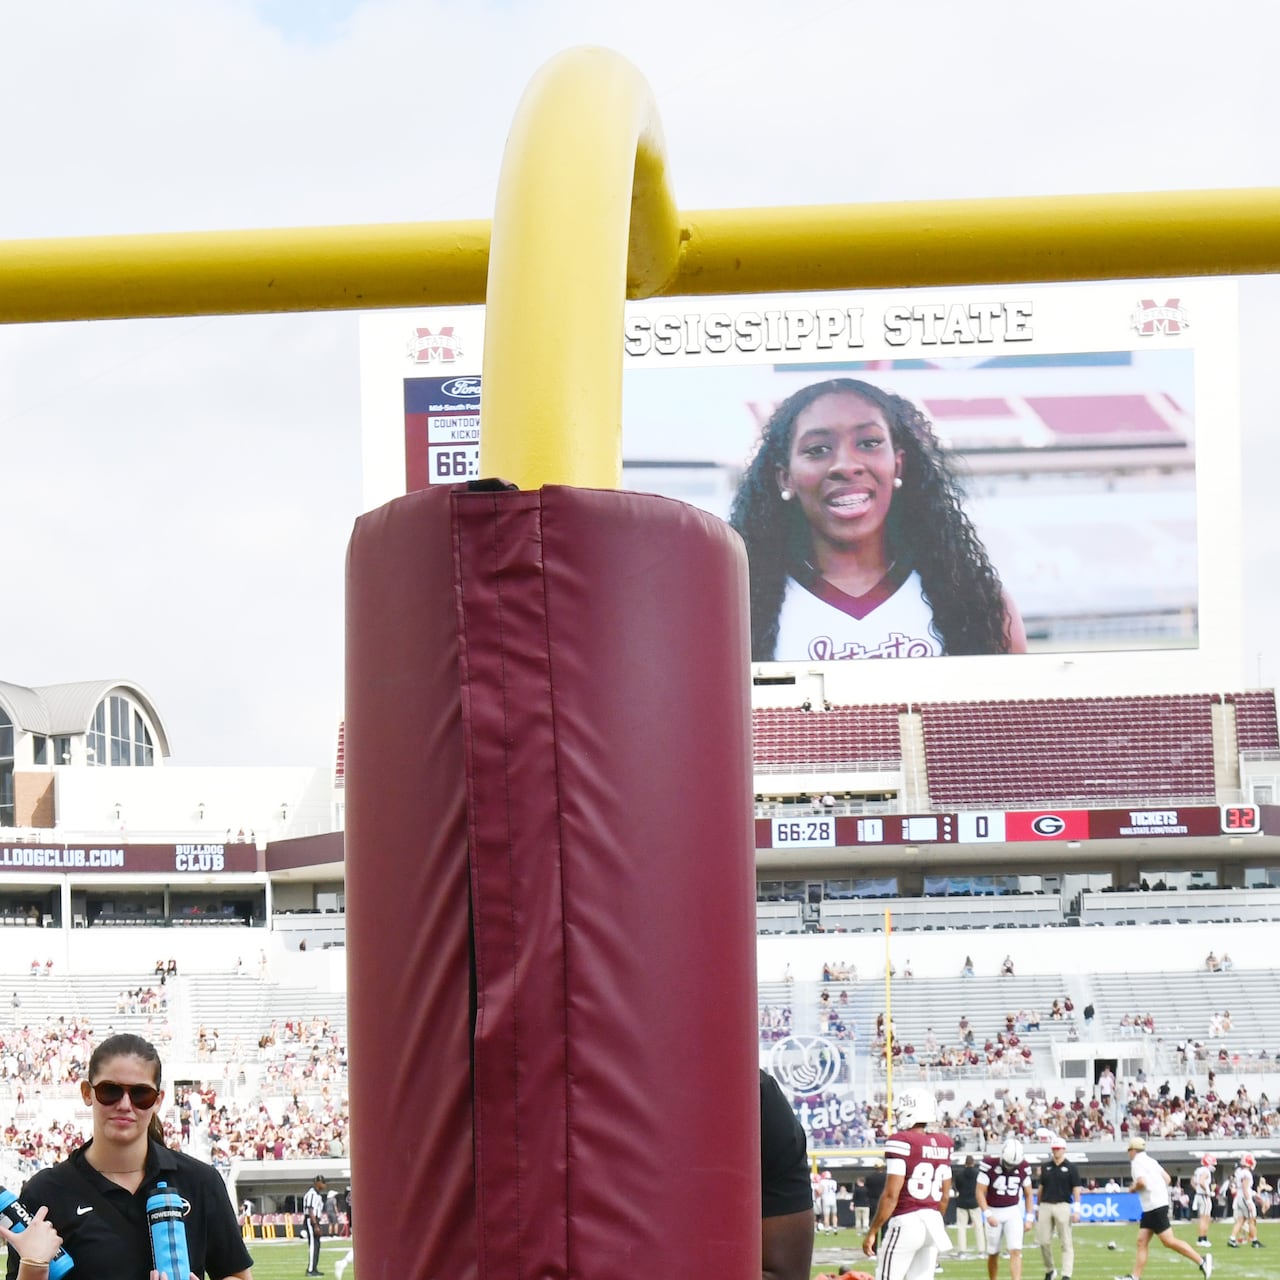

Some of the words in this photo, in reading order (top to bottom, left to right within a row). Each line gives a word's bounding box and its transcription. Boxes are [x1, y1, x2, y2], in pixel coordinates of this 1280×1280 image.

[624, 308, 865, 356] SSISSIPPI
[884, 301, 1034, 347] STATE
[434, 417, 480, 429] COUNTDO
[451, 429, 480, 440] KICKO
[436, 450, 479, 477] 66:
[976, 816, 988, 838] 0
[1033, 816, 1064, 836] G
[1128, 811, 1178, 826] TICKETS
[1228, 807, 1255, 829] 32
[778, 821, 831, 843] 66:28
[175, 844, 225, 857] BULLDOG
[175, 854, 225, 872] CLUB
[792, 1099, 857, 1132] tate
[992, 1175, 1021, 1197] 45
[1076, 1197, 1121, 1219] ook
